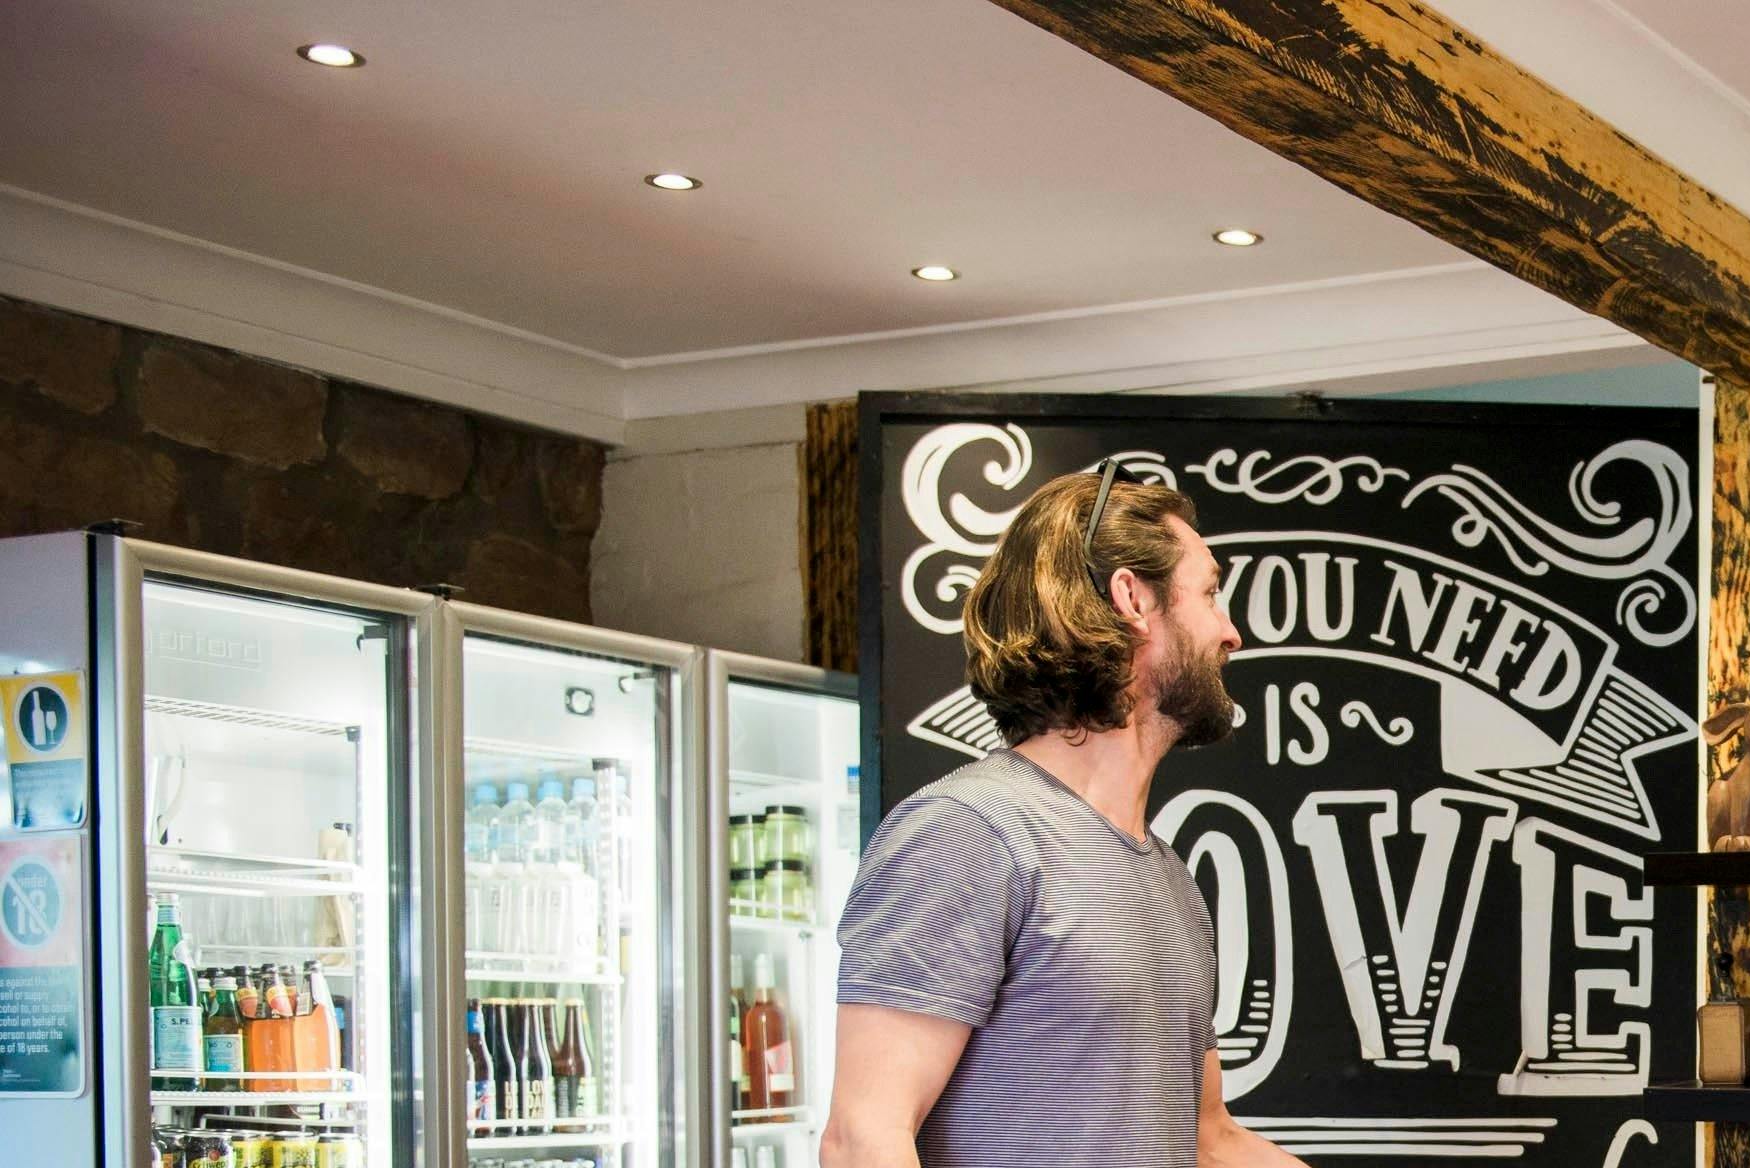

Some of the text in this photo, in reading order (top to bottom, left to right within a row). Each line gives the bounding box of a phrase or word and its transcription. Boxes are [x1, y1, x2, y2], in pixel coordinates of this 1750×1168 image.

[1265, 682, 1329, 766] IS
[12, 889, 48, 935] 18
[1150, 787, 1654, 1102] OVE
[0, 1003, 19, 1014] cohol
[0, 1015, 19, 1027] cohol
[27, 1028, 49, 1041] under
[50, 1028, 63, 1040] the
